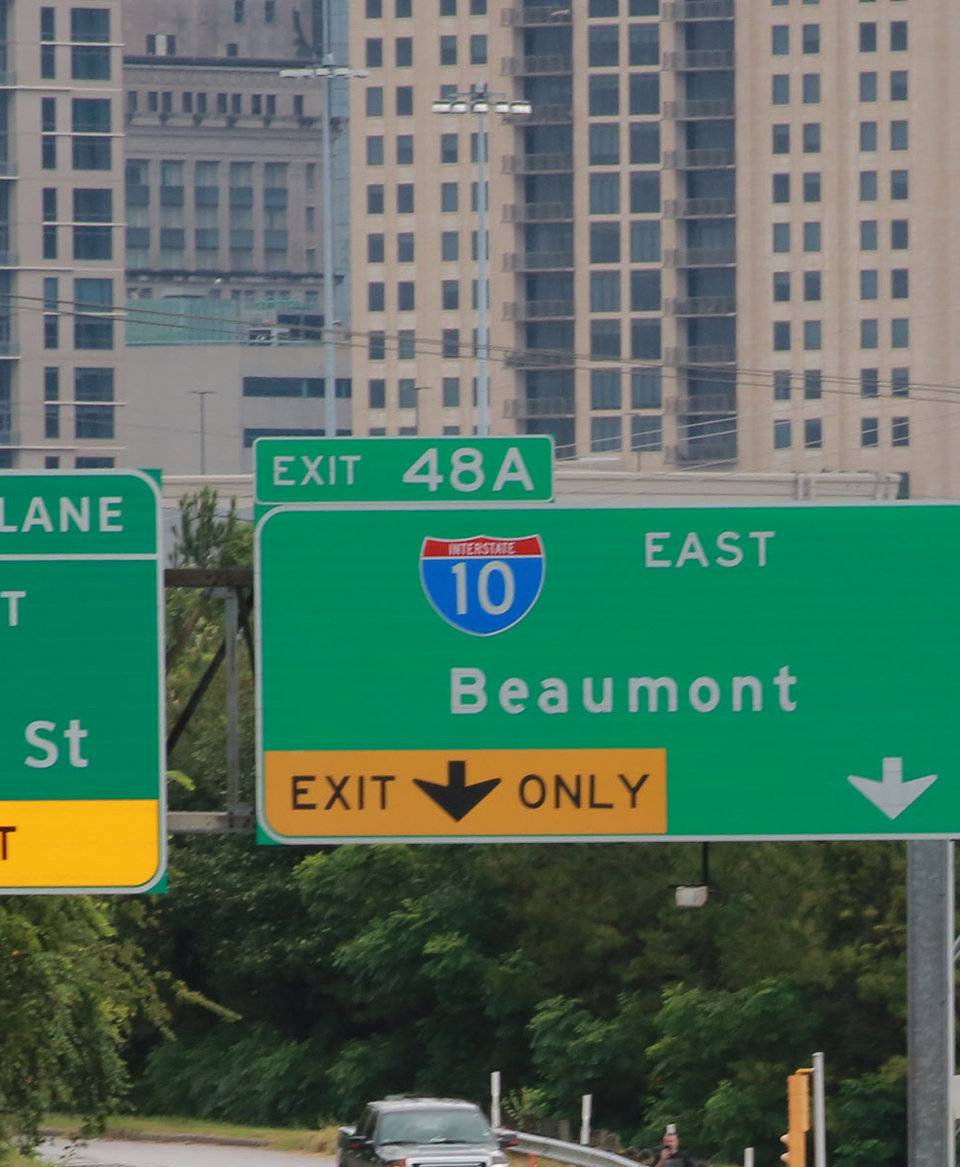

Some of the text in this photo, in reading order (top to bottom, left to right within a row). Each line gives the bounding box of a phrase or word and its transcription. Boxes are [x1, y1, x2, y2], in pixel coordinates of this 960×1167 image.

[273, 447, 534, 492] EXIT 48A
[448, 541, 518, 556] INTERSTATE
[645, 531, 775, 568] EAST
[450, 559, 515, 616] 10
[450, 665, 797, 714] Beaumont
[25, 719, 88, 769] St
[292, 774, 650, 811] EXIT ONLY
